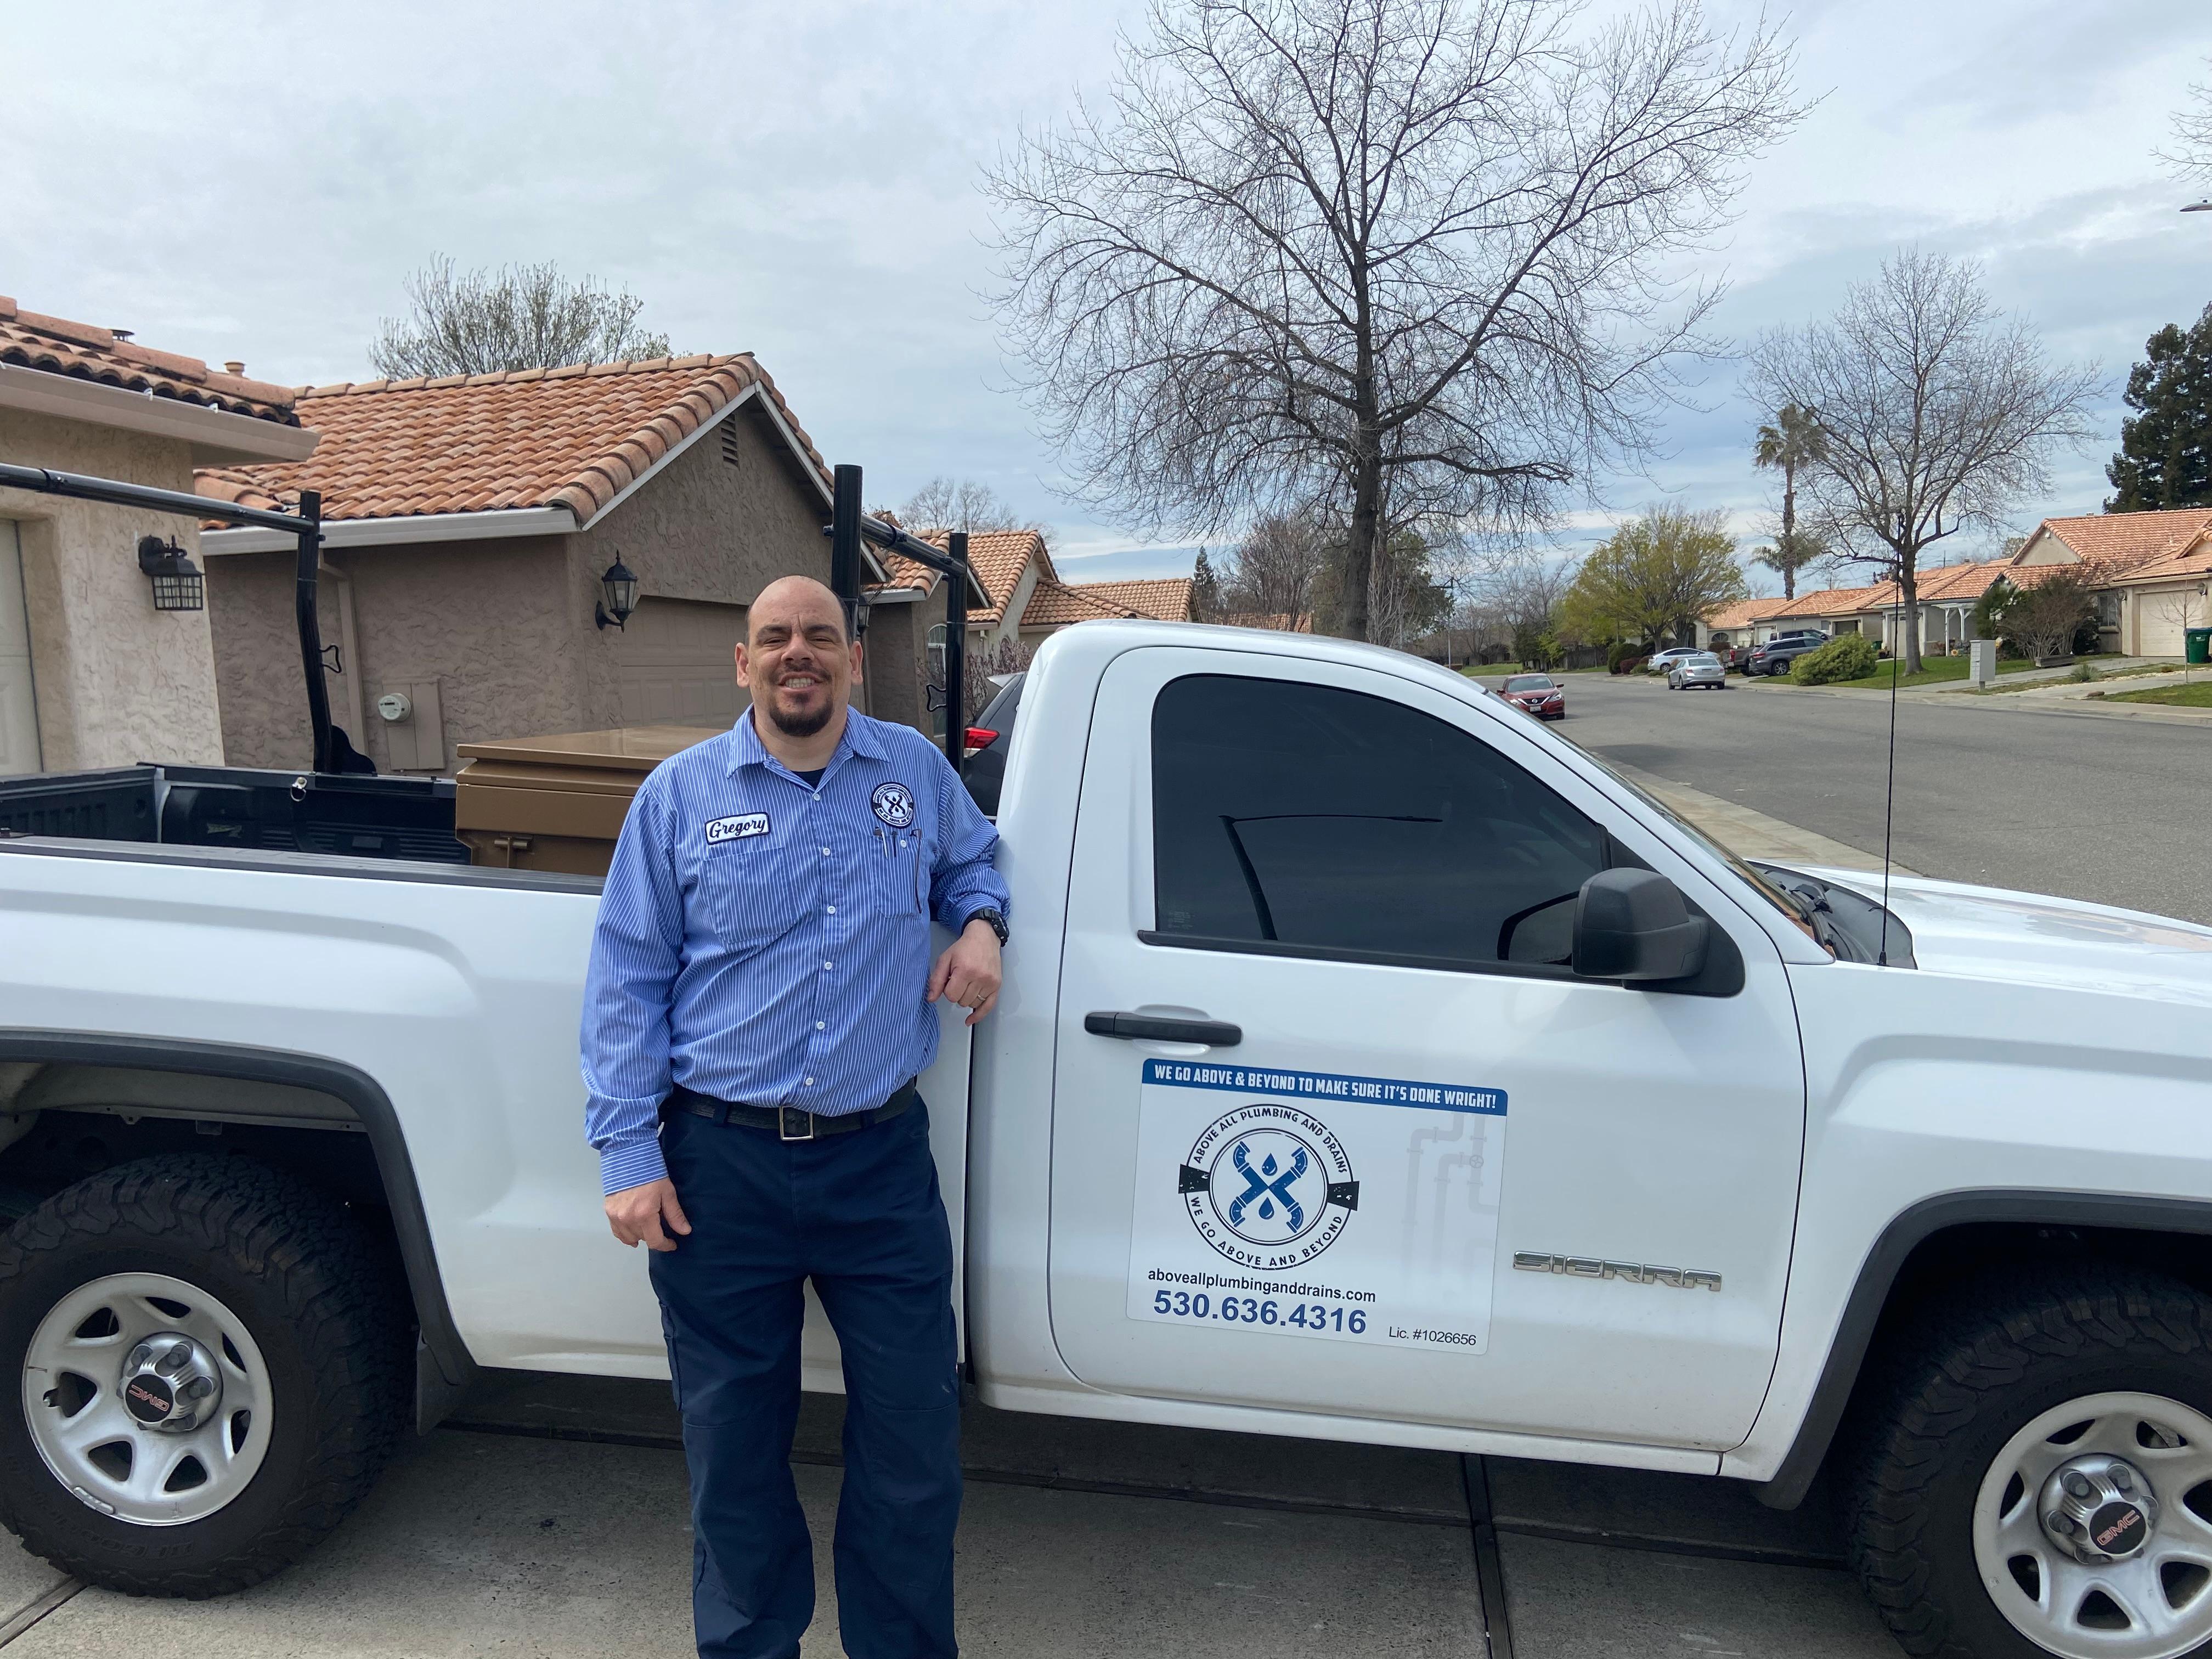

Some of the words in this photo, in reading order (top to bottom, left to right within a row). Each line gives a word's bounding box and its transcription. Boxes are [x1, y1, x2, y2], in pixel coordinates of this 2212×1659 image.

[709, 820, 765, 838] Gregory
[1154, 1064, 1172, 1080] WE
[1175, 1067, 1191, 1081] GO
[1193, 1068, 1233, 1085] ABOVE
[1235, 1071, 1245, 1086] &
[1248, 1073, 1295, 1091] BEYOND
[1299, 1077, 1313, 1092] TO
[1316, 1079, 1349, 1096] MAKE
[1351, 1082, 1382, 1098] SURE
[1384, 1085, 1407, 1101] IT'S
[1409, 1087, 1441, 1104] DONE
[1444, 1090, 1497, 1109] WRIGHT!
[1193, 1129, 1219, 1164] ABOVE
[1219, 1116, 1238, 1132] ALL
[1240, 1108, 1299, 1122] PLUMBING
[1301, 1118, 1323, 1137] AND
[1322, 1136, 1348, 1173] DRAINS
[1190, 1197, 1203, 1216] WE
[1201, 1222, 1216, 1238] GO
[1218, 1241, 1261, 1266] ABOVE
[1269, 1254, 1296, 1267] AND
[1301, 1216, 1342, 1258] BEYOND
[1148, 1268, 1376, 1302] aboveallplumbinganddrains.com
[1513, 1250, 1723, 1292] SIERRA
[1153, 1290, 1367, 1334] 530.636.4316
[1389, 1326, 1409, 1339] Lic.
[1413, 1329, 1476, 1345] #1026656
[129, 1384, 170, 1412] GMC
[2097, 1510, 2140, 1545] GMC
